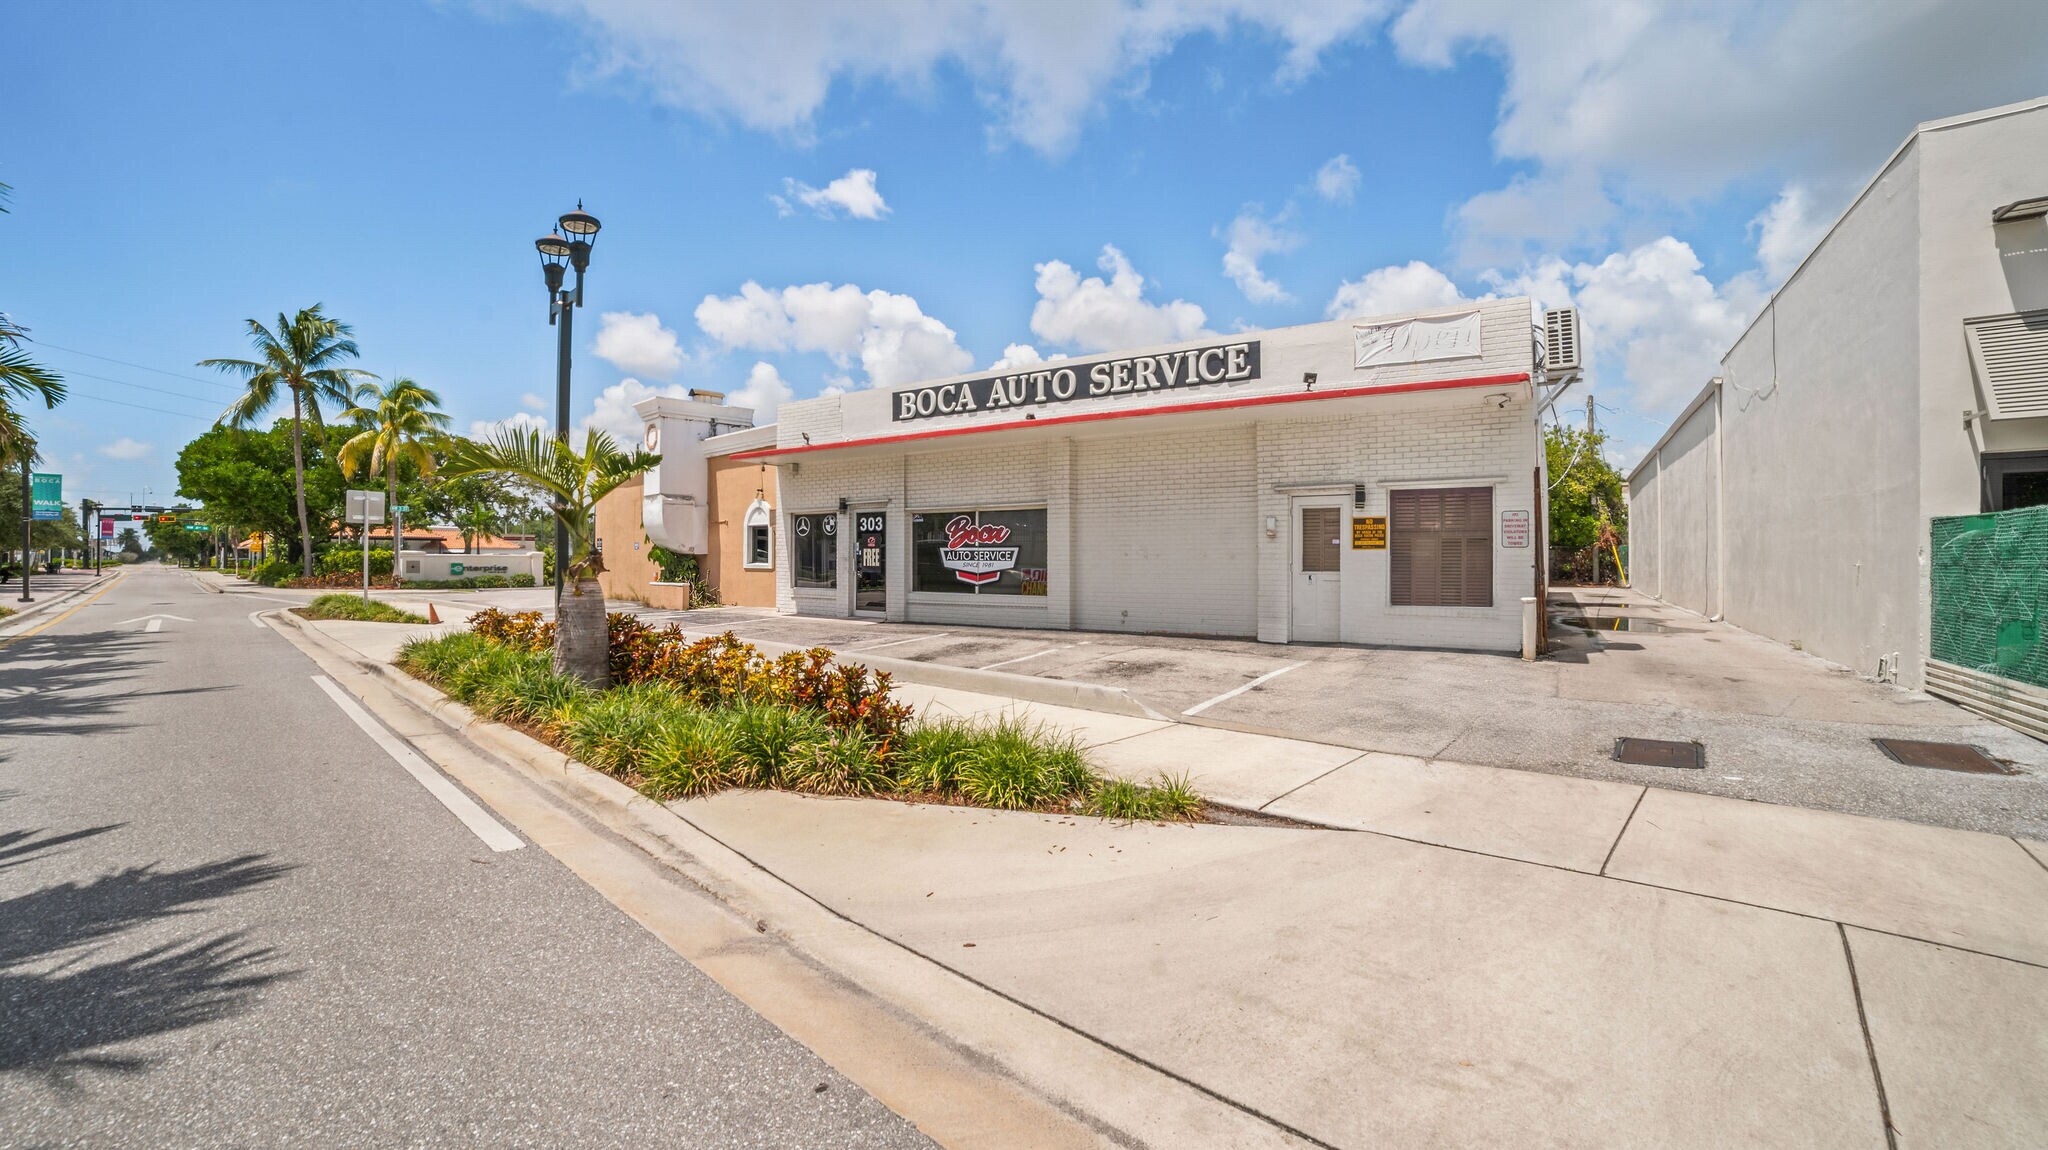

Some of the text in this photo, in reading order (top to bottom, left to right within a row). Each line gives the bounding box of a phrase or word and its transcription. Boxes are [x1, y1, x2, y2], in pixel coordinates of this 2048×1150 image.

[899, 344, 1252, 420] BOCA AUTO SERVICE
[860, 517, 883, 531] 303
[946, 515, 1010, 550] Boca
[863, 548, 880, 567] FREE
[946, 550, 1012, 561] AUTO SERVICE
[451, 564, 508, 572] enterprise
